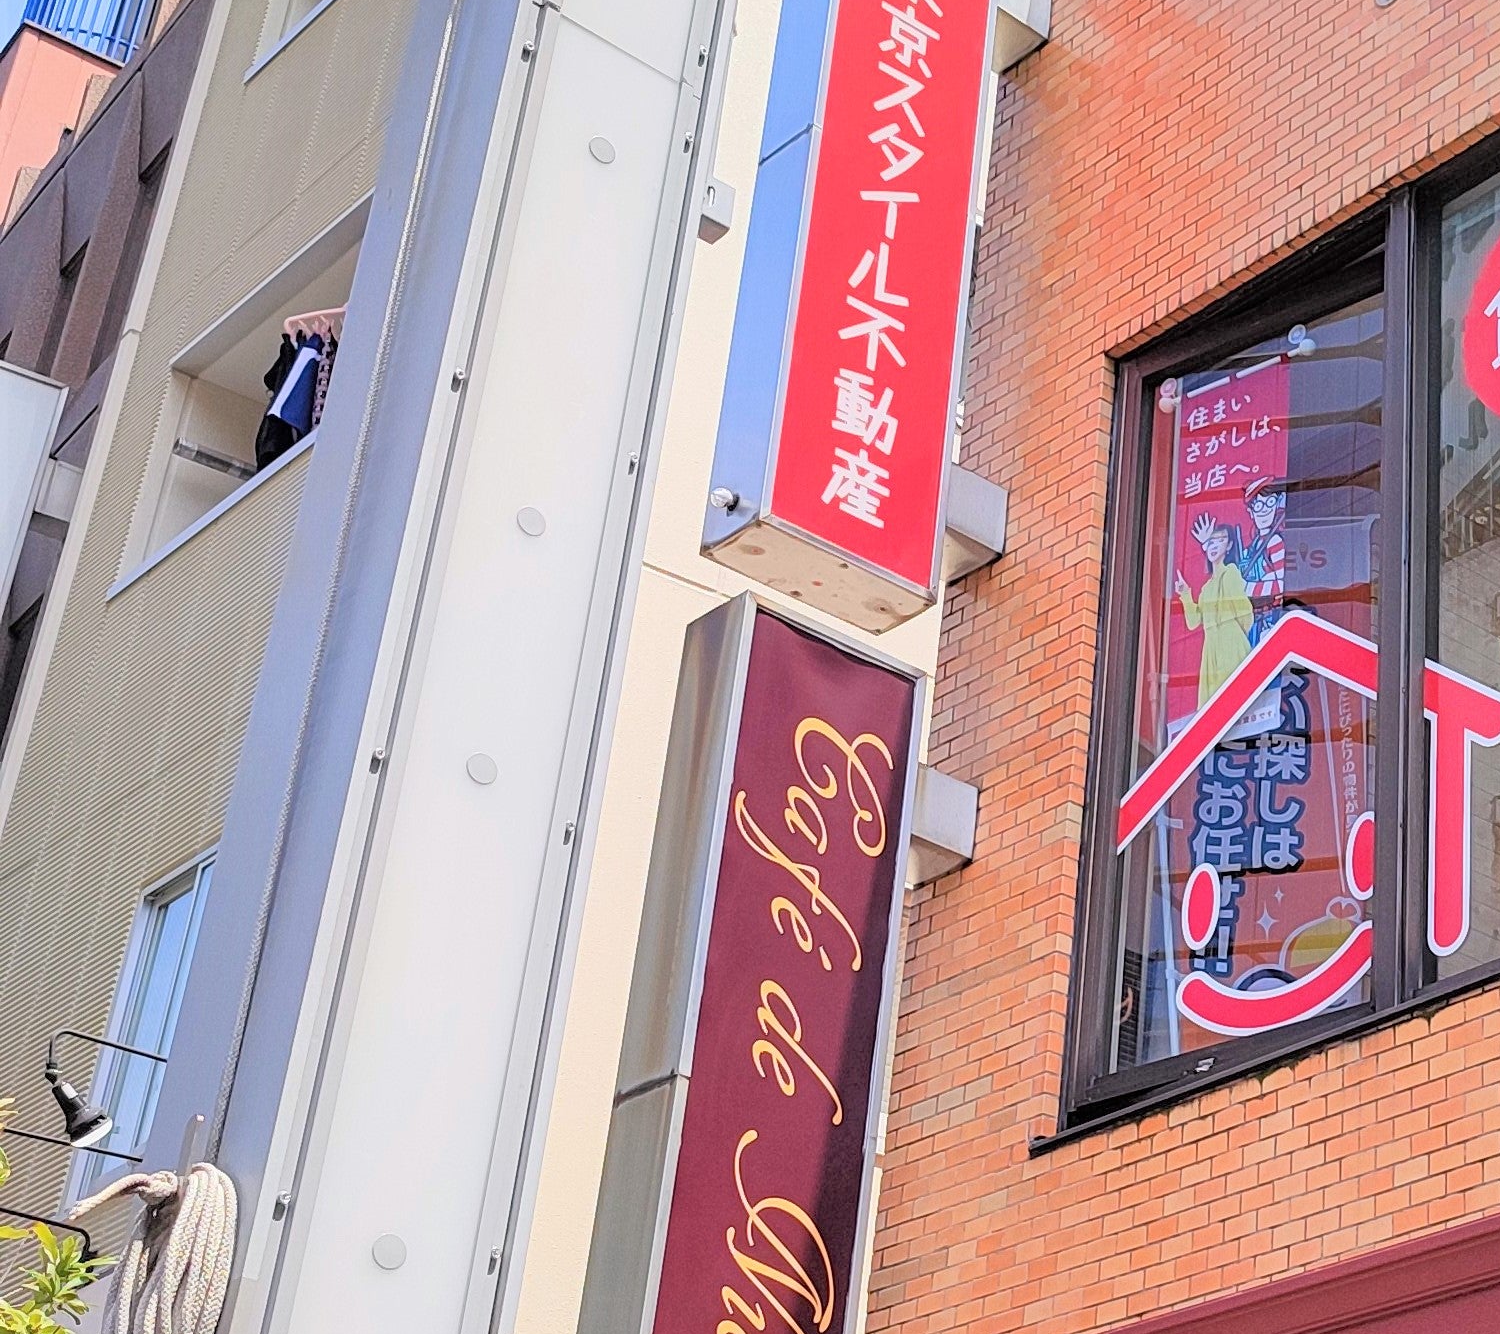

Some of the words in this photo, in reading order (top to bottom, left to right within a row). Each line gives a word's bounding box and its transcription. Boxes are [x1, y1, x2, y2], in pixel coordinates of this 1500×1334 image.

[1186, 394, 1252, 432] 住まい
[1185, 415, 1281, 463] さがしは、
[1183, 464, 1260, 499] 当店へ。
[735, 716, 895, 973] Café
[751, 979, 844, 1125] de
